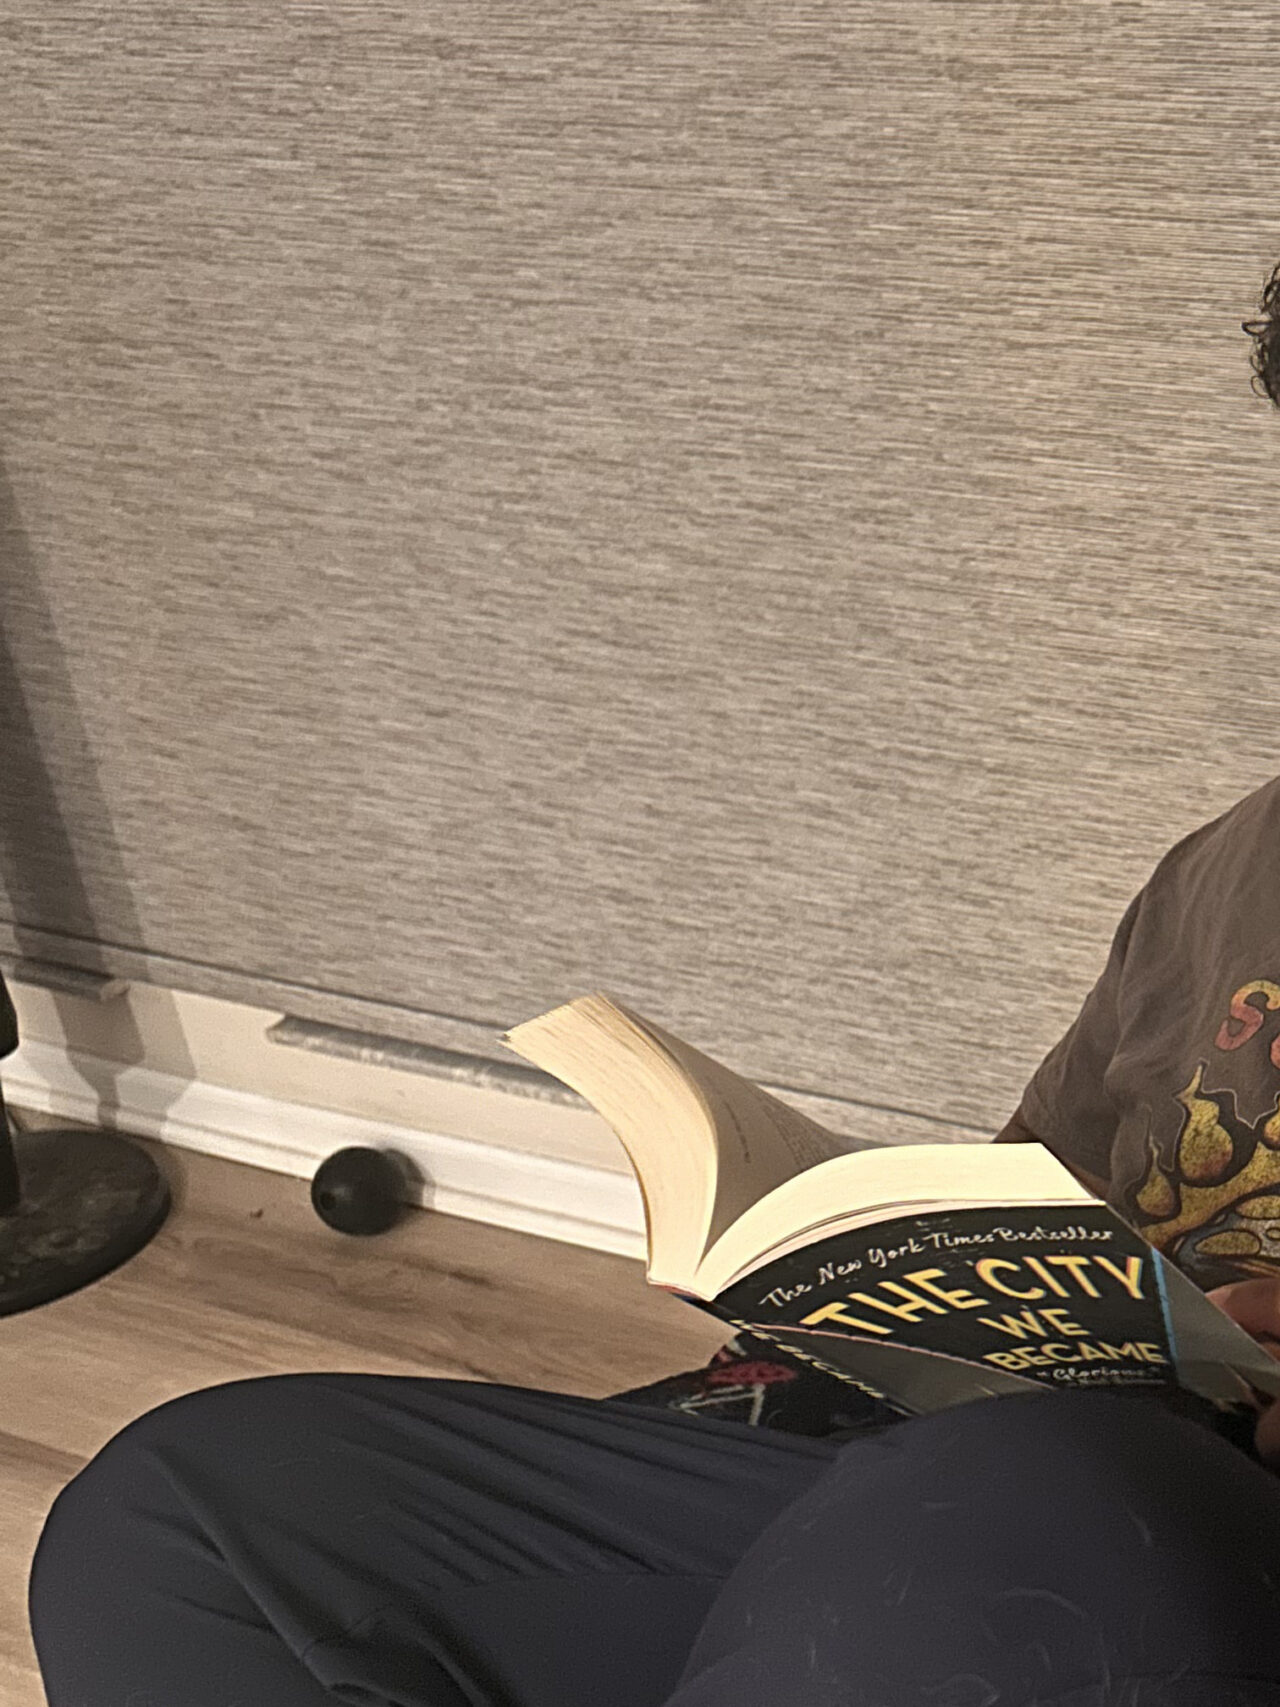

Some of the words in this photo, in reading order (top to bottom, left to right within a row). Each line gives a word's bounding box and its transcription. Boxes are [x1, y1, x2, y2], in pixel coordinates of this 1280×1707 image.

[758, 1284, 813, 1308] The
[818, 1259, 862, 1286] New
[867, 1237, 926, 1269] York
[922, 1231, 995, 1248] Times
[993, 1225, 1113, 1242] Bestseller
[799, 1268, 991, 1335] THE
[975, 1255, 1146, 1300] CITY
[976, 1307, 1091, 1339] WE
[982, 1341, 1168, 1371] BECAME
